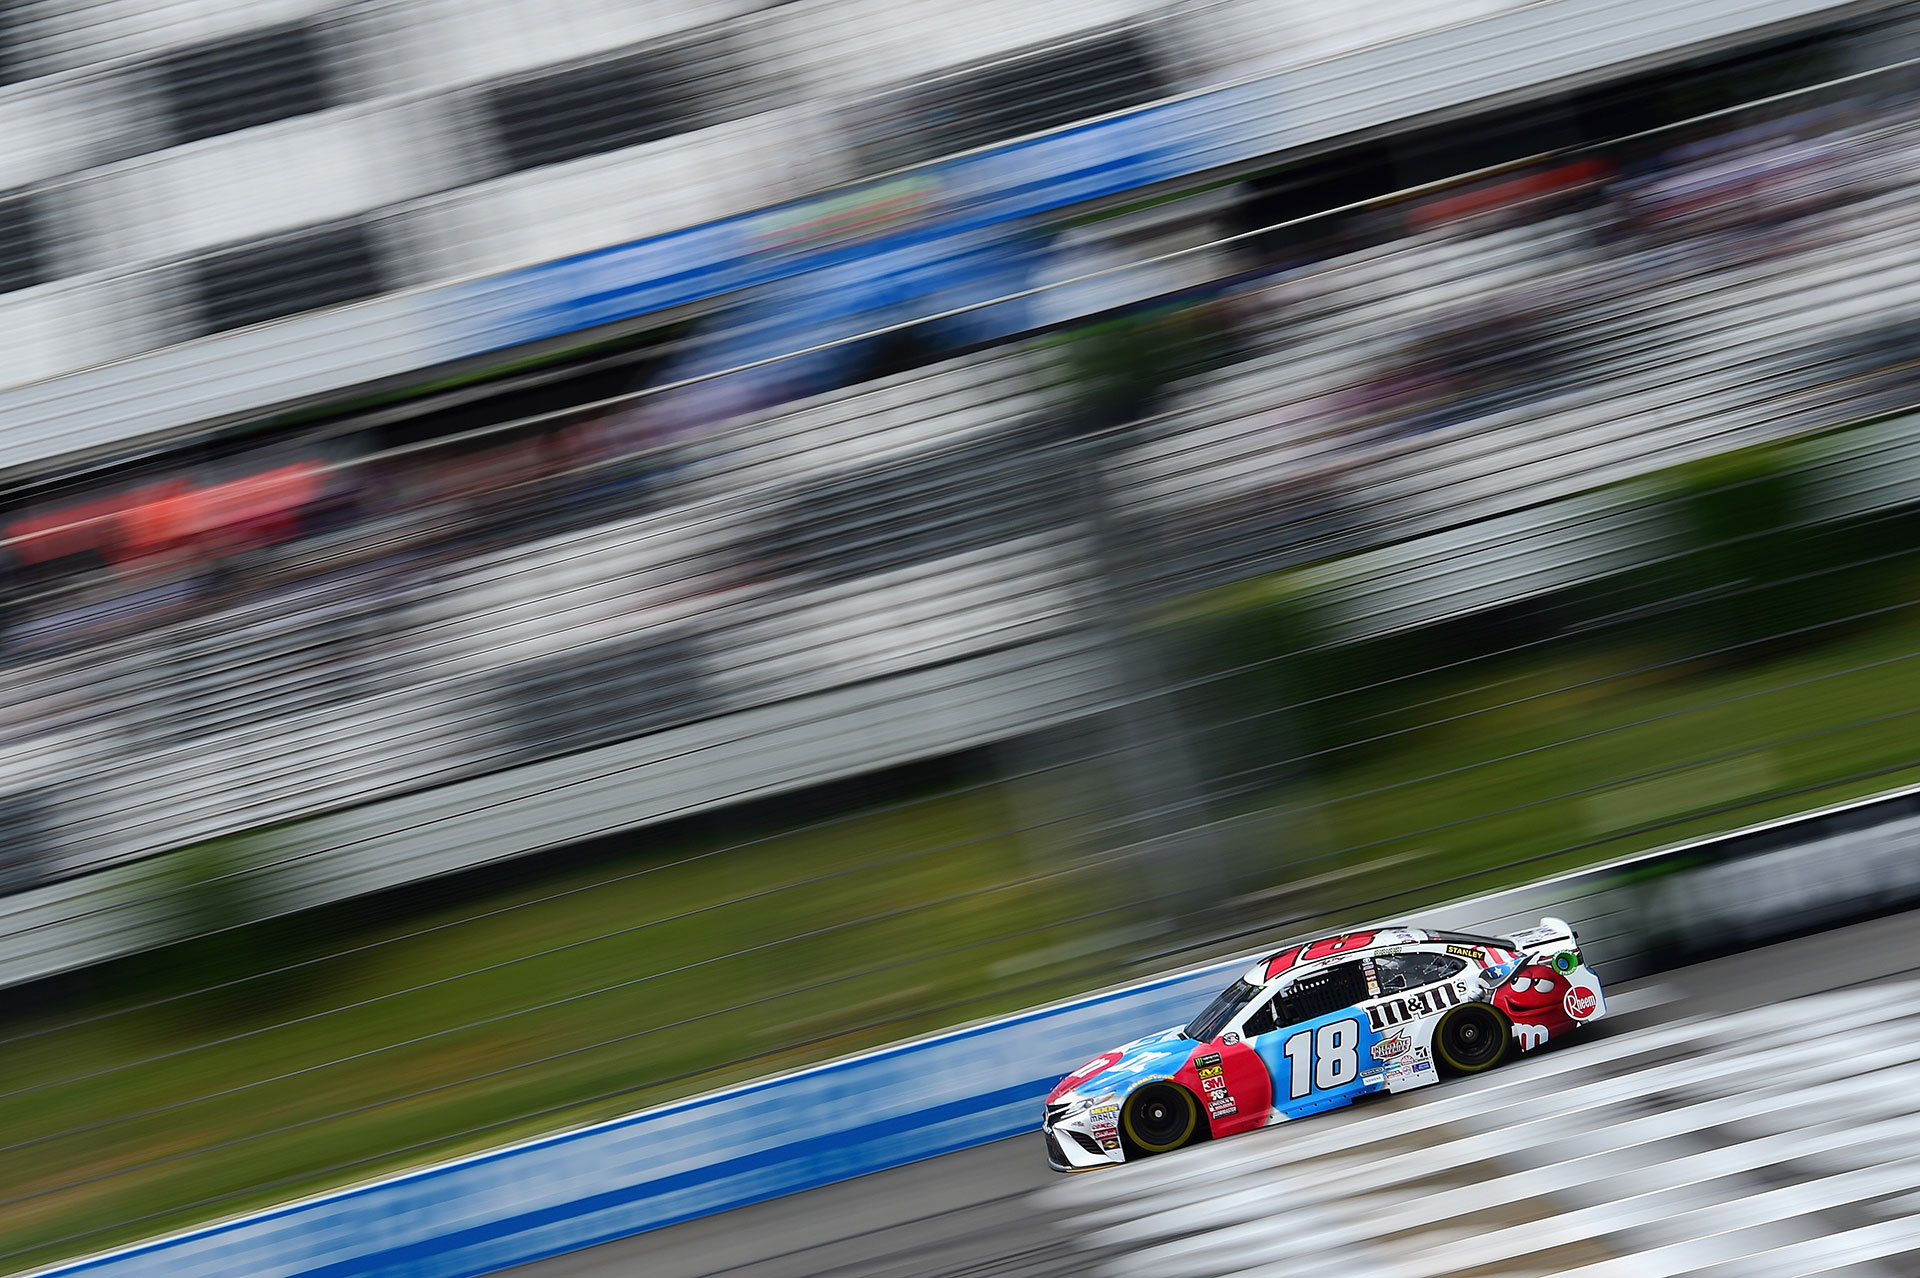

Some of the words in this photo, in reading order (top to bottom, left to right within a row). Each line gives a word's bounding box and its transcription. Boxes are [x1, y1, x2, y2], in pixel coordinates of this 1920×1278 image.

[1448, 946, 1483, 958] STANLEY
[1567, 988, 1595, 1015] Rheem
[1373, 1039, 1409, 1053] INTERSTATE
[1375, 1046, 1408, 1058] BATTERIES
[1284, 1017, 1359, 1101] 18
[1204, 1076, 1223, 1090] 3M
[1090, 1111, 1117, 1122] MAHLE
